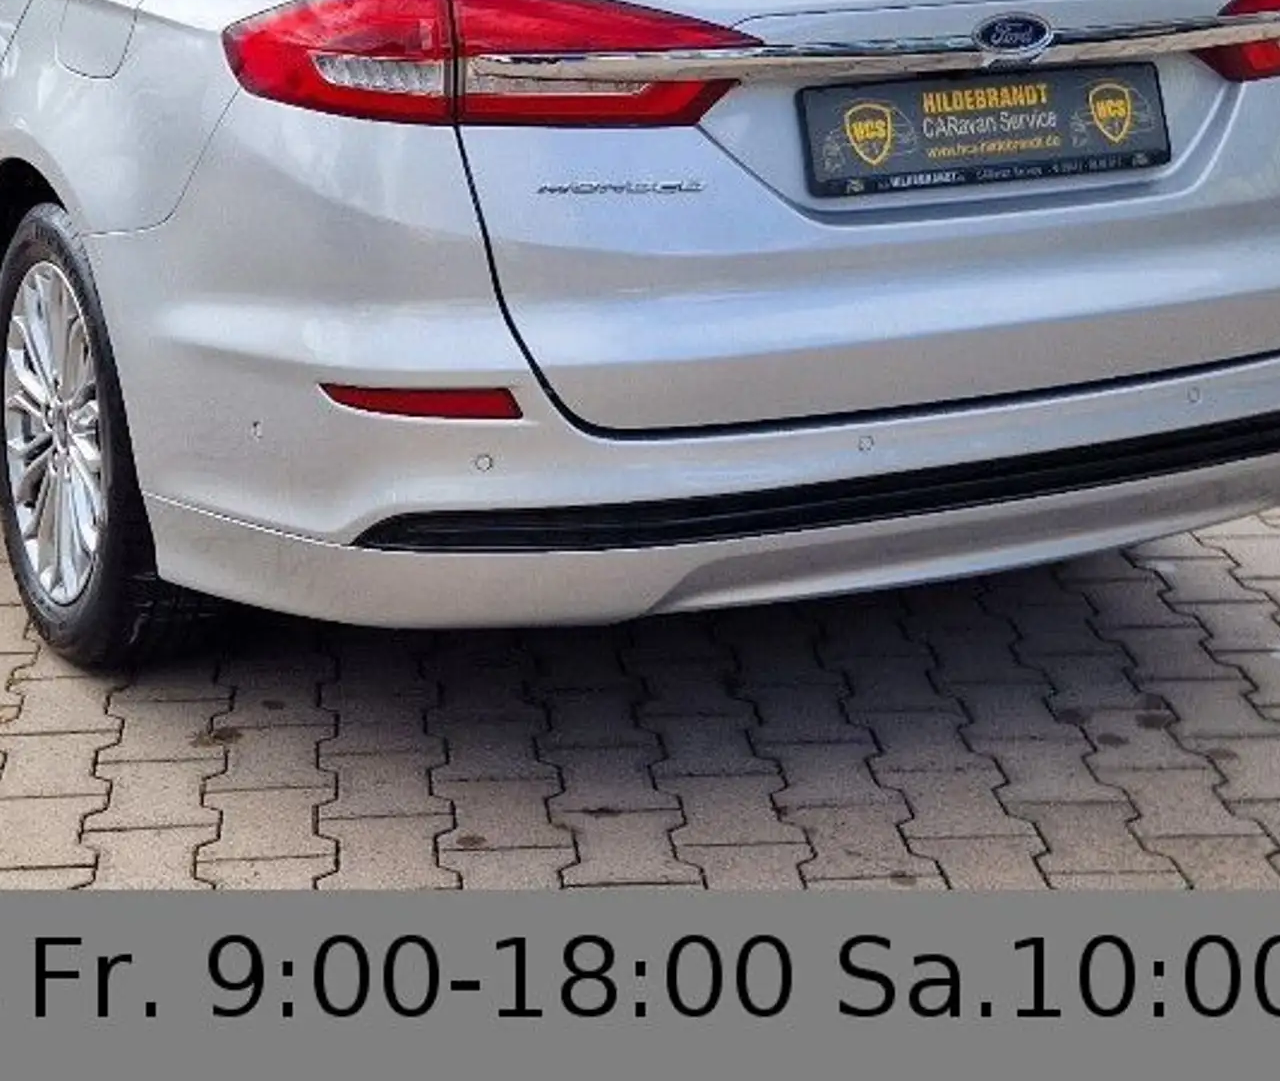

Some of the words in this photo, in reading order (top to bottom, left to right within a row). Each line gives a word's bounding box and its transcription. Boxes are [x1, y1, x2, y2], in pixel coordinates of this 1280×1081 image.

[990, 21, 1033, 45] Ford
[922, 83, 1048, 113] HILDEBRANDT
[1095, 98, 1127, 120] HCS
[851, 119, 887, 141] HCS
[922, 115, 997, 139] CARavan
[999, 109, 1058, 132] Service
